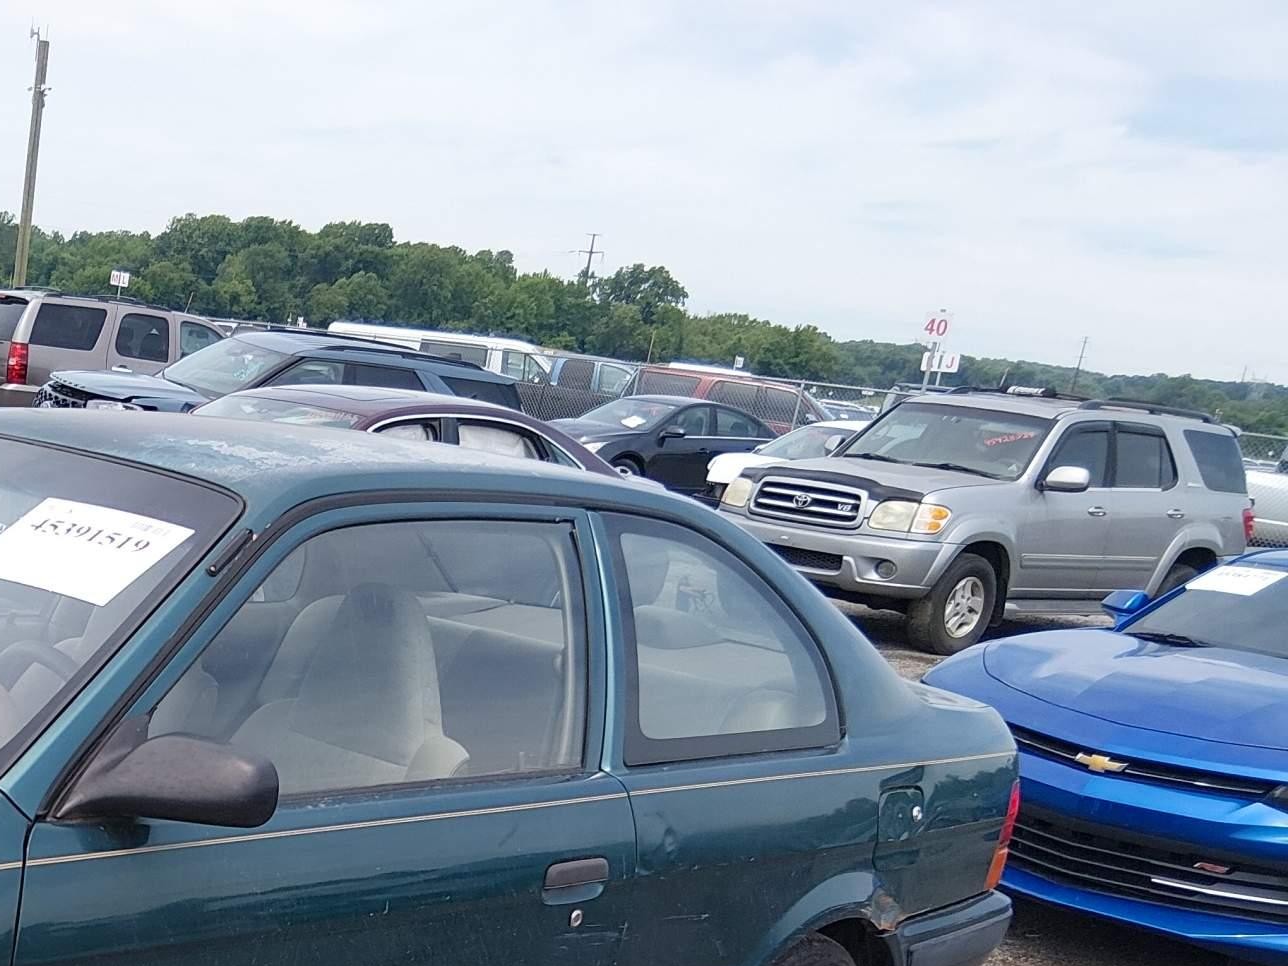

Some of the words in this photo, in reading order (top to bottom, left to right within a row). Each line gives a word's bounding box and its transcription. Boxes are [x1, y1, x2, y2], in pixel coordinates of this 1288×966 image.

[924, 318, 948, 336] 40
[945, 356, 955, 369] J
[836, 503, 852, 512] V8
[30, 518, 151, 552] 45391519
